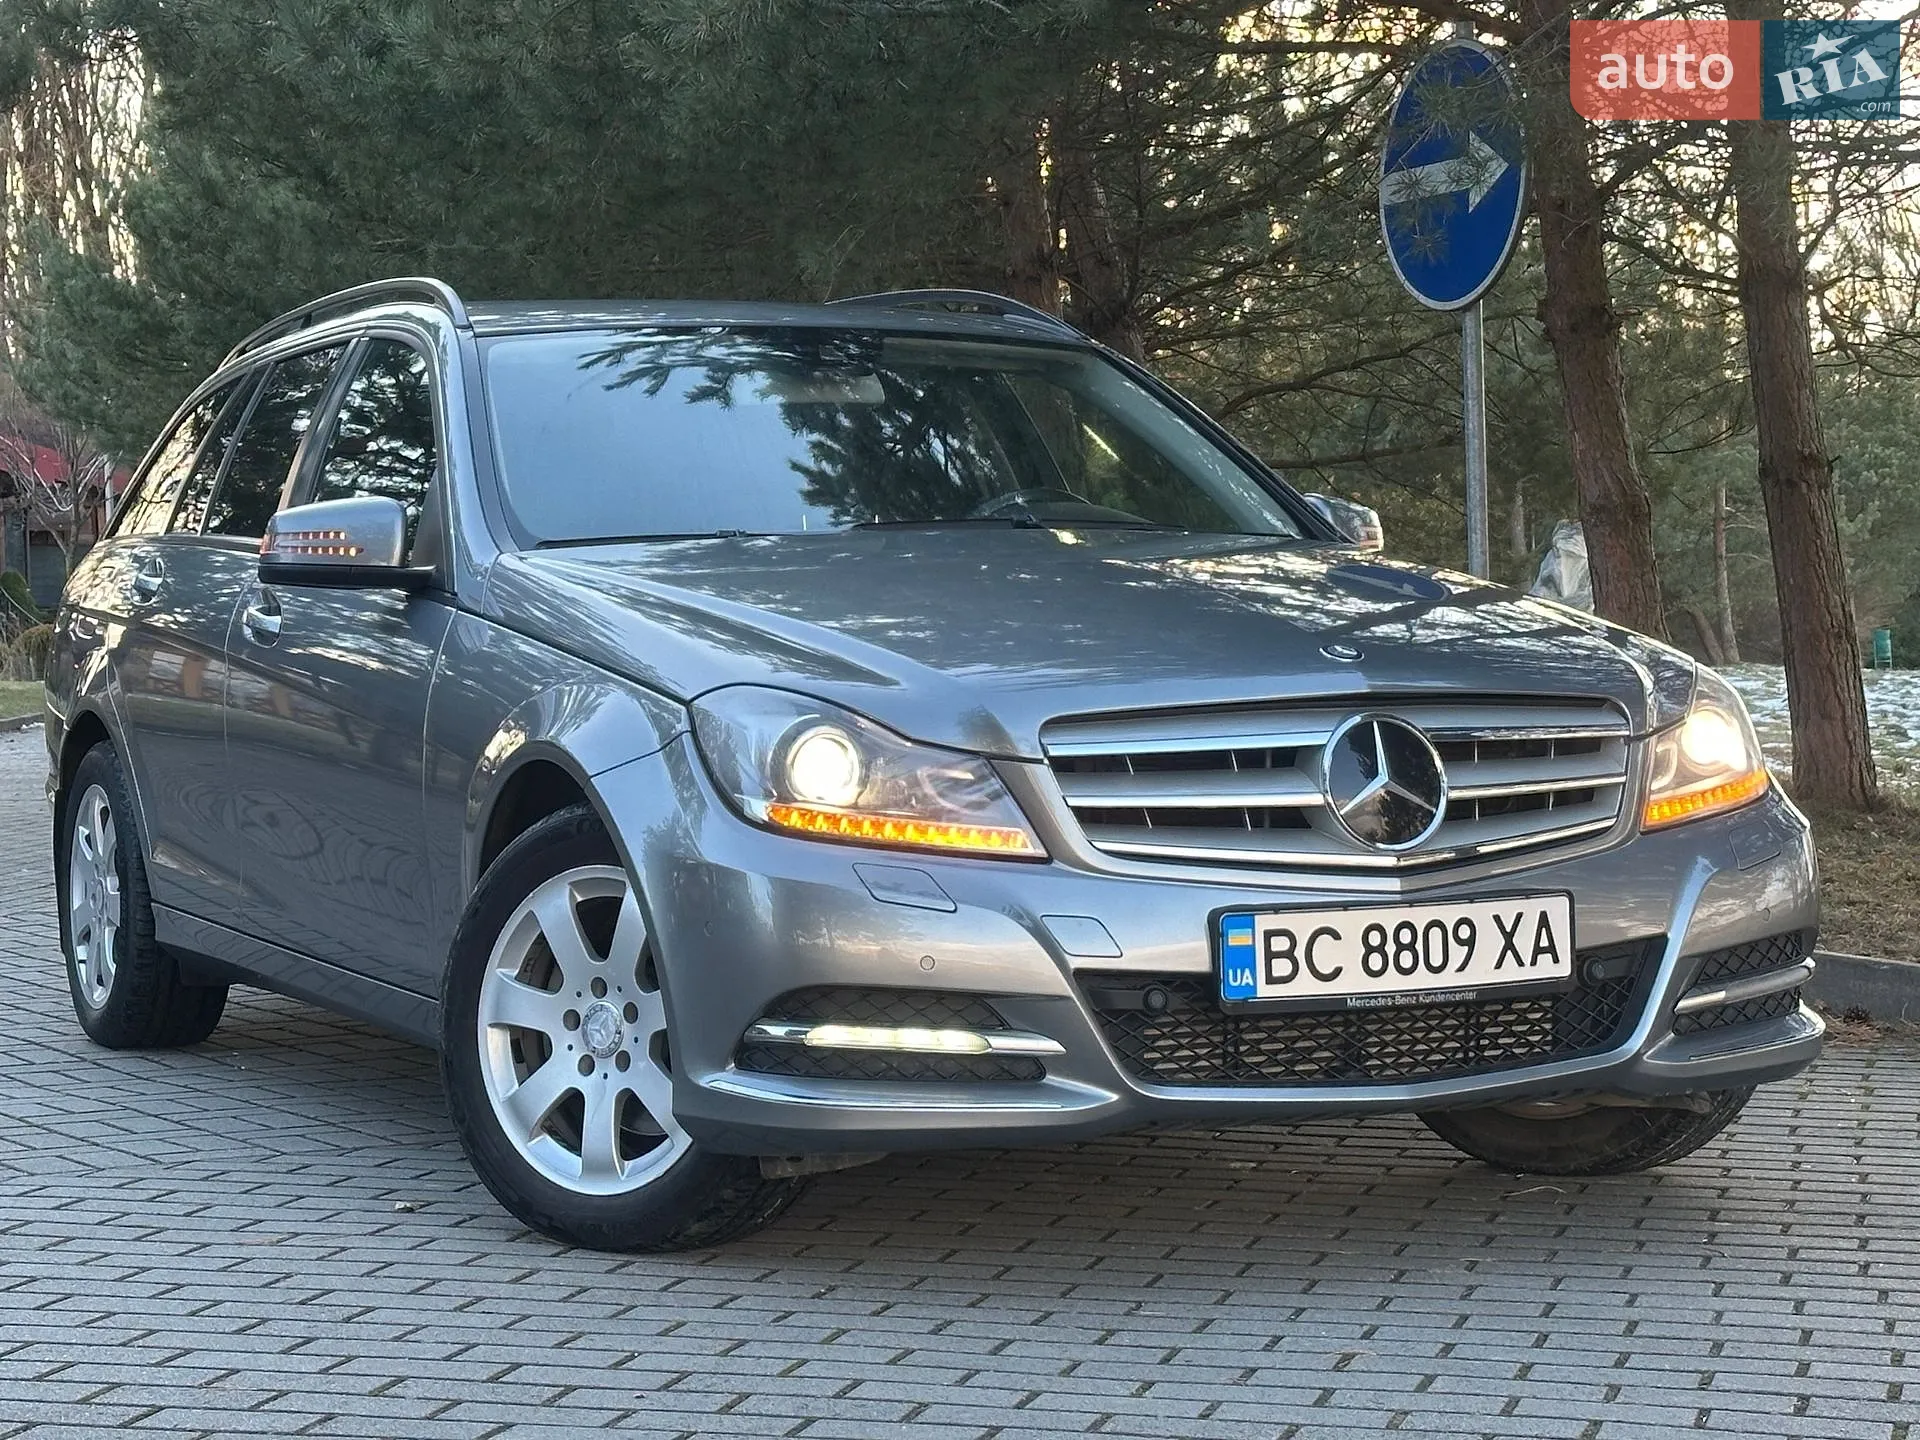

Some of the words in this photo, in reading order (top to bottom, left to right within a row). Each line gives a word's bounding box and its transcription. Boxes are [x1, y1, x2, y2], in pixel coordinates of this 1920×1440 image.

[1263, 926, 1343, 985] BC
[1361, 917, 1477, 979] 8809
[1492, 910, 1560, 971] XA
[1228, 969, 1255, 987] UA
[1346, 995, 1417, 1008] Mercedes-Benz
[1419, 990, 1478, 1004] Kundencenter
